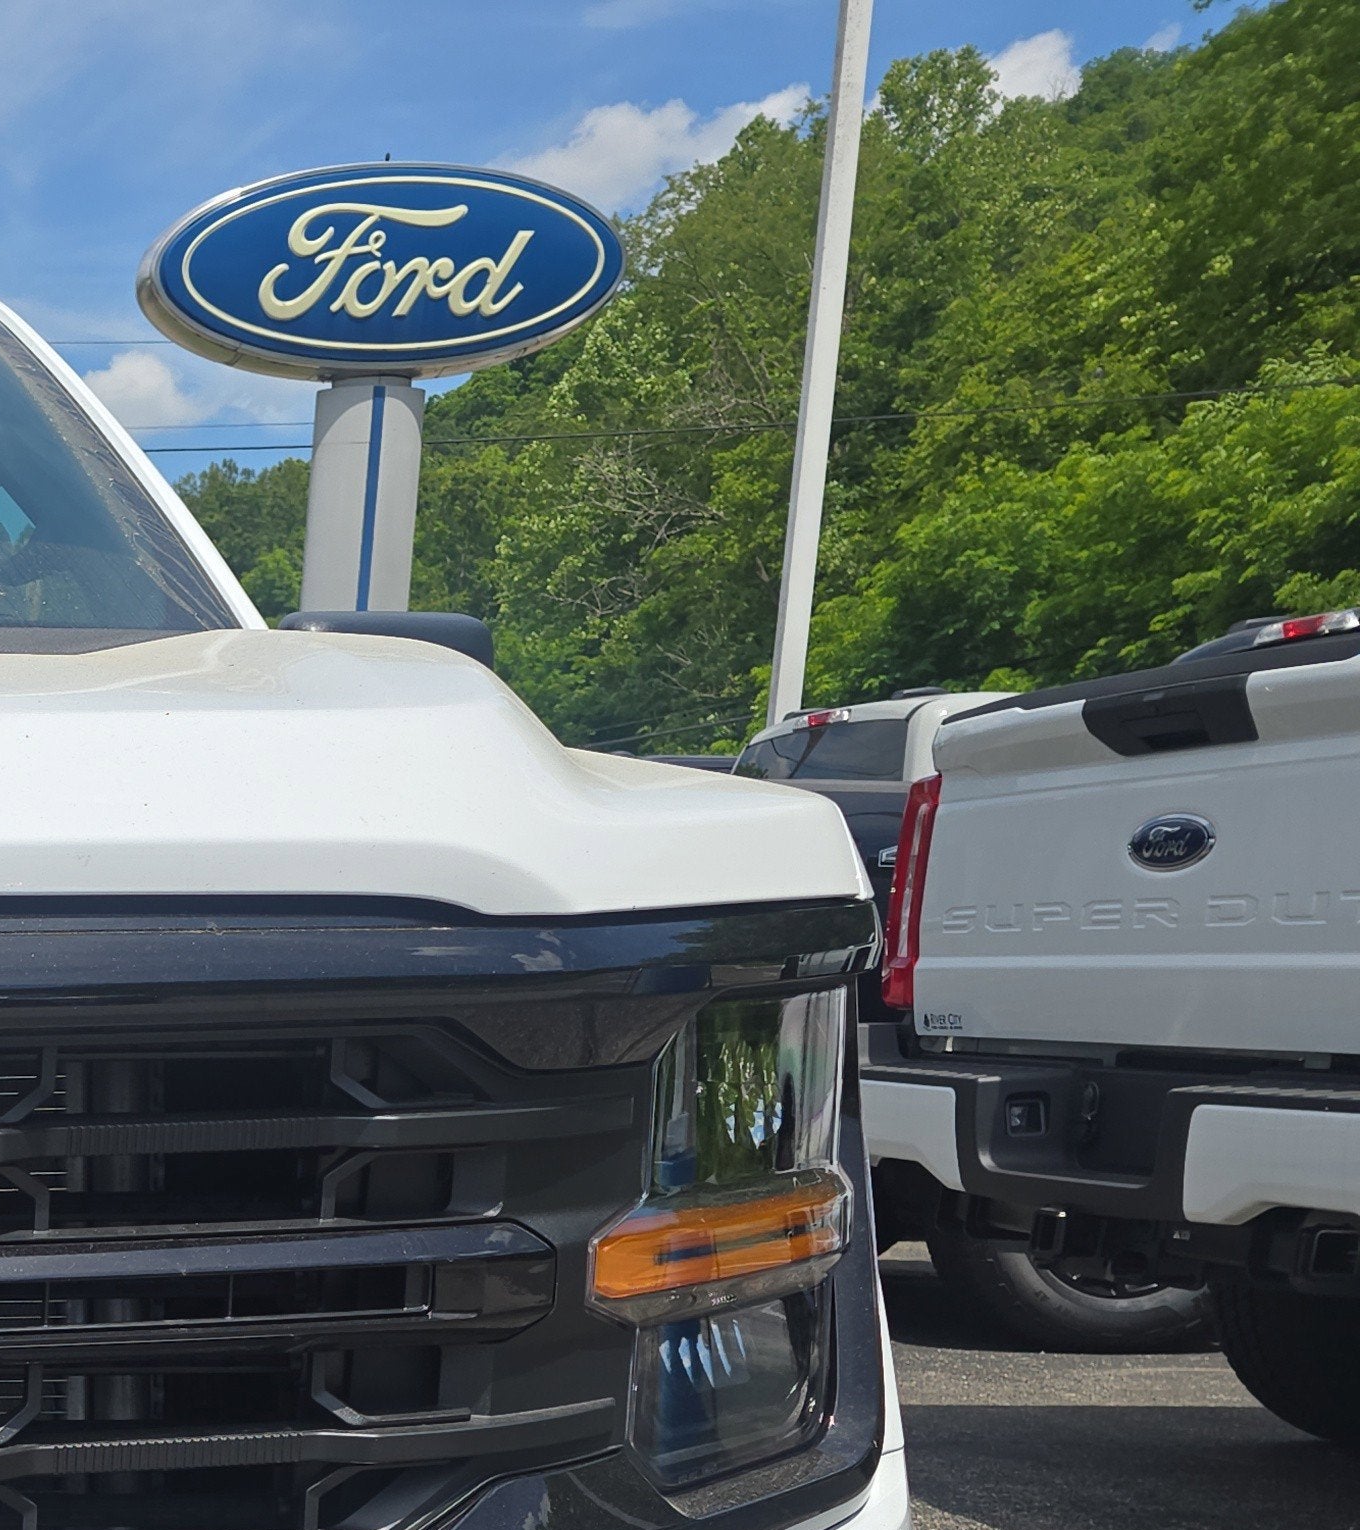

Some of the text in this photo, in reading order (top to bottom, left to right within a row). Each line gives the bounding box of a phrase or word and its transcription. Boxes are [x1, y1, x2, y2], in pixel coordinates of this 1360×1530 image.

[258, 203, 535, 320] Ford
[1142, 826, 1192, 858] Ford
[941, 897, 1180, 934] SUPER
